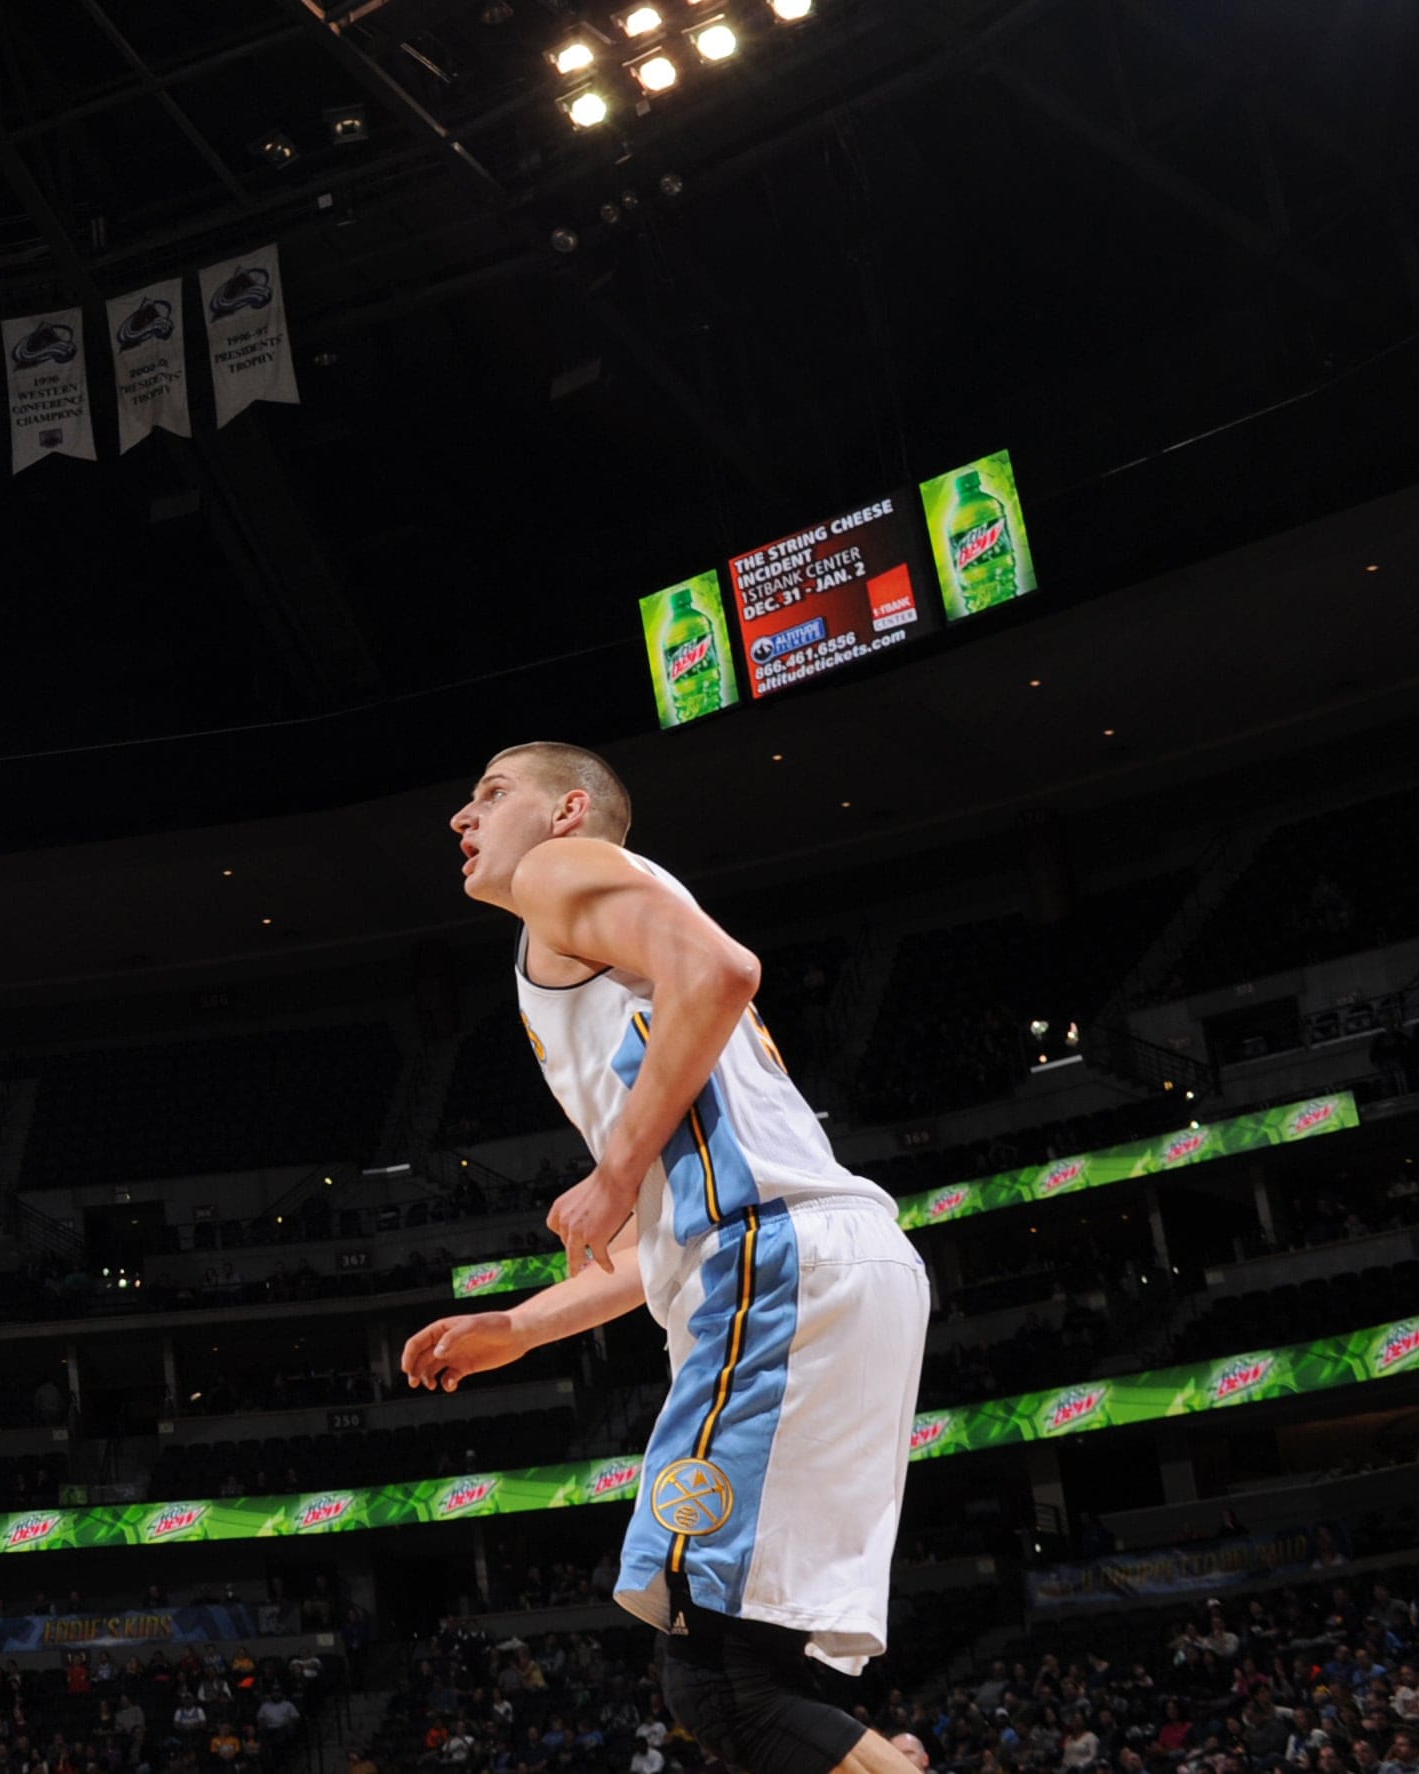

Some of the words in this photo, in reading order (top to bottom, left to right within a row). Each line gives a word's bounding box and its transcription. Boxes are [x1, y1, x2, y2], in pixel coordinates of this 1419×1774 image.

[228, 352, 275, 374] TROPHY
[16, 408, 83, 427] CHAMPIONS
[735, 553, 765, 574] THE
[767, 526, 828, 556] STRING
[831, 499, 894, 534] CHEESE
[737, 549, 813, 589] INCIDENT
[742, 571, 804, 604] 1STBANK
[806, 546, 861, 578] CENTER
[743, 598, 780, 621] DEC.
[783, 587, 801, 606] 31
[815, 568, 852, 593] JAN.
[854, 562, 866, 577] 2
[754, 631, 857, 680] 866.461.6556
[757, 629, 906, 694] altitudetickets.com
[340, 1254, 366, 1267] 367
[333, 1414, 359, 1427] 250
